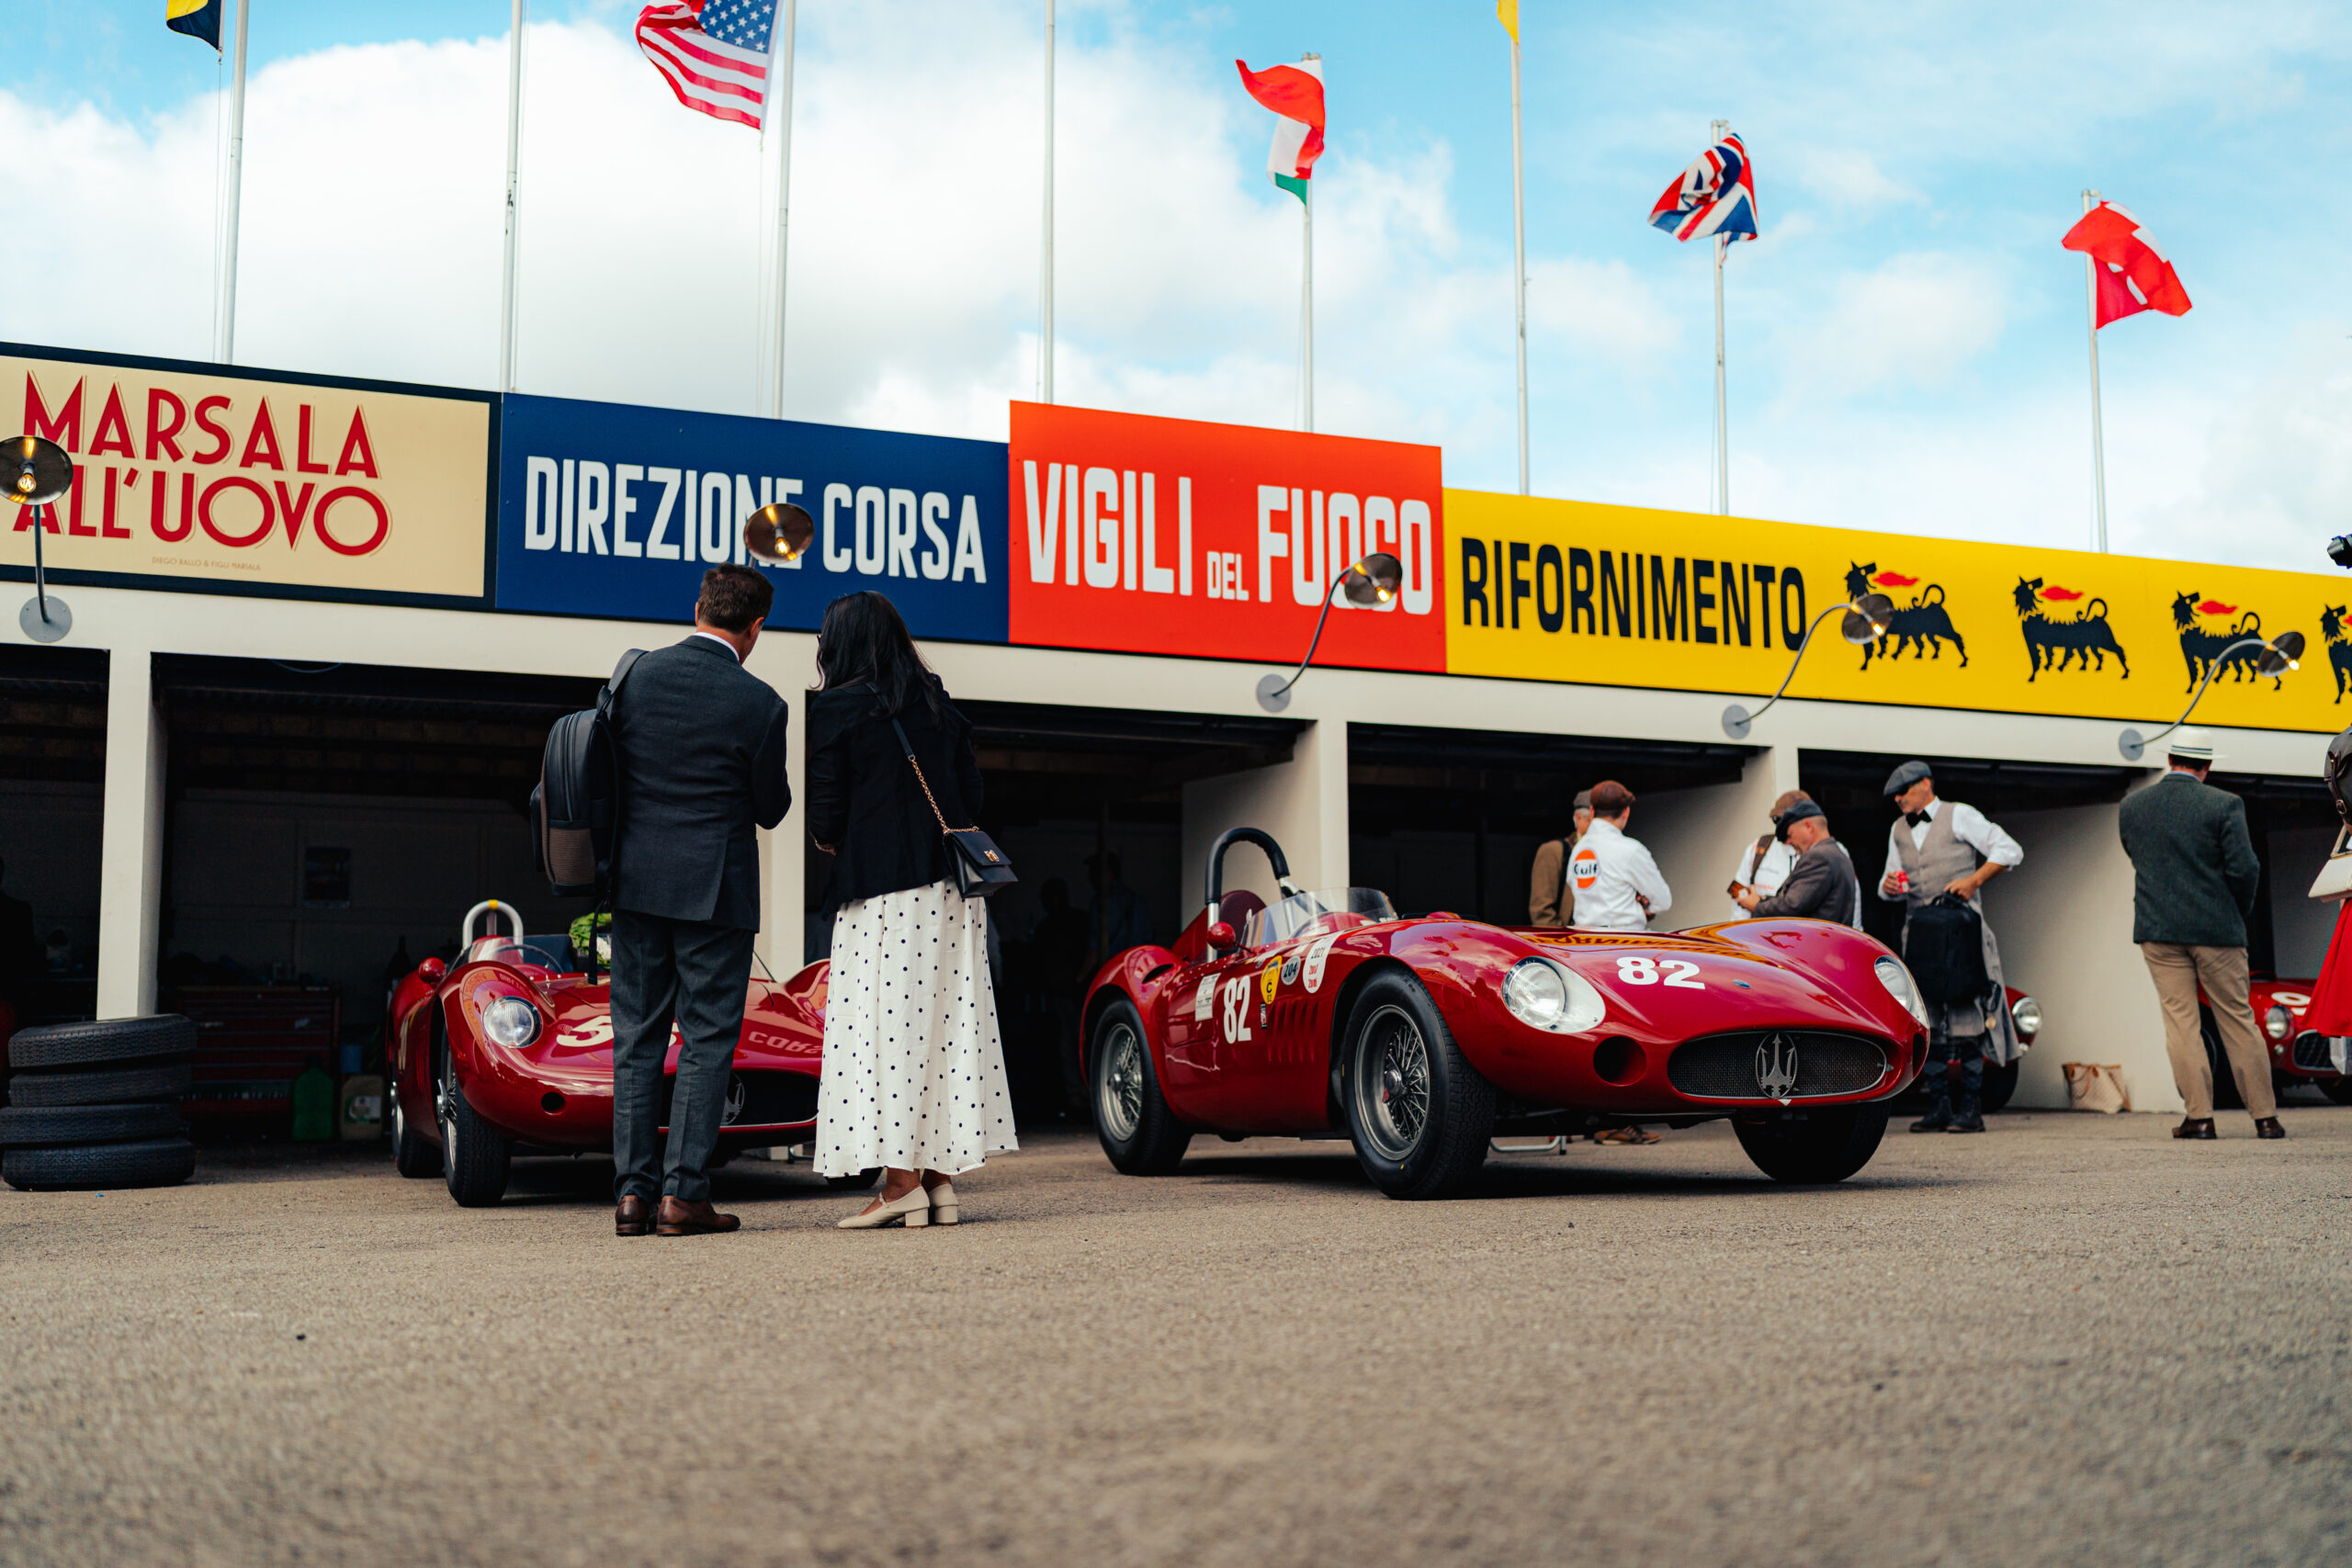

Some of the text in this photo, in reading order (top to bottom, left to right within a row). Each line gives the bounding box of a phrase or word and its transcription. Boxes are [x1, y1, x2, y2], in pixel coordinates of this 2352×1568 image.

[23, 369, 382, 479] MARSALA
[823, 482, 988, 584] CORSA
[1023, 459, 1434, 615] VIGILI DEL FUOCO
[1461, 536, 1807, 652] RIFORNIMENTO
[1223, 976, 1252, 1044] 82
[1616, 956, 1706, 990] 82
